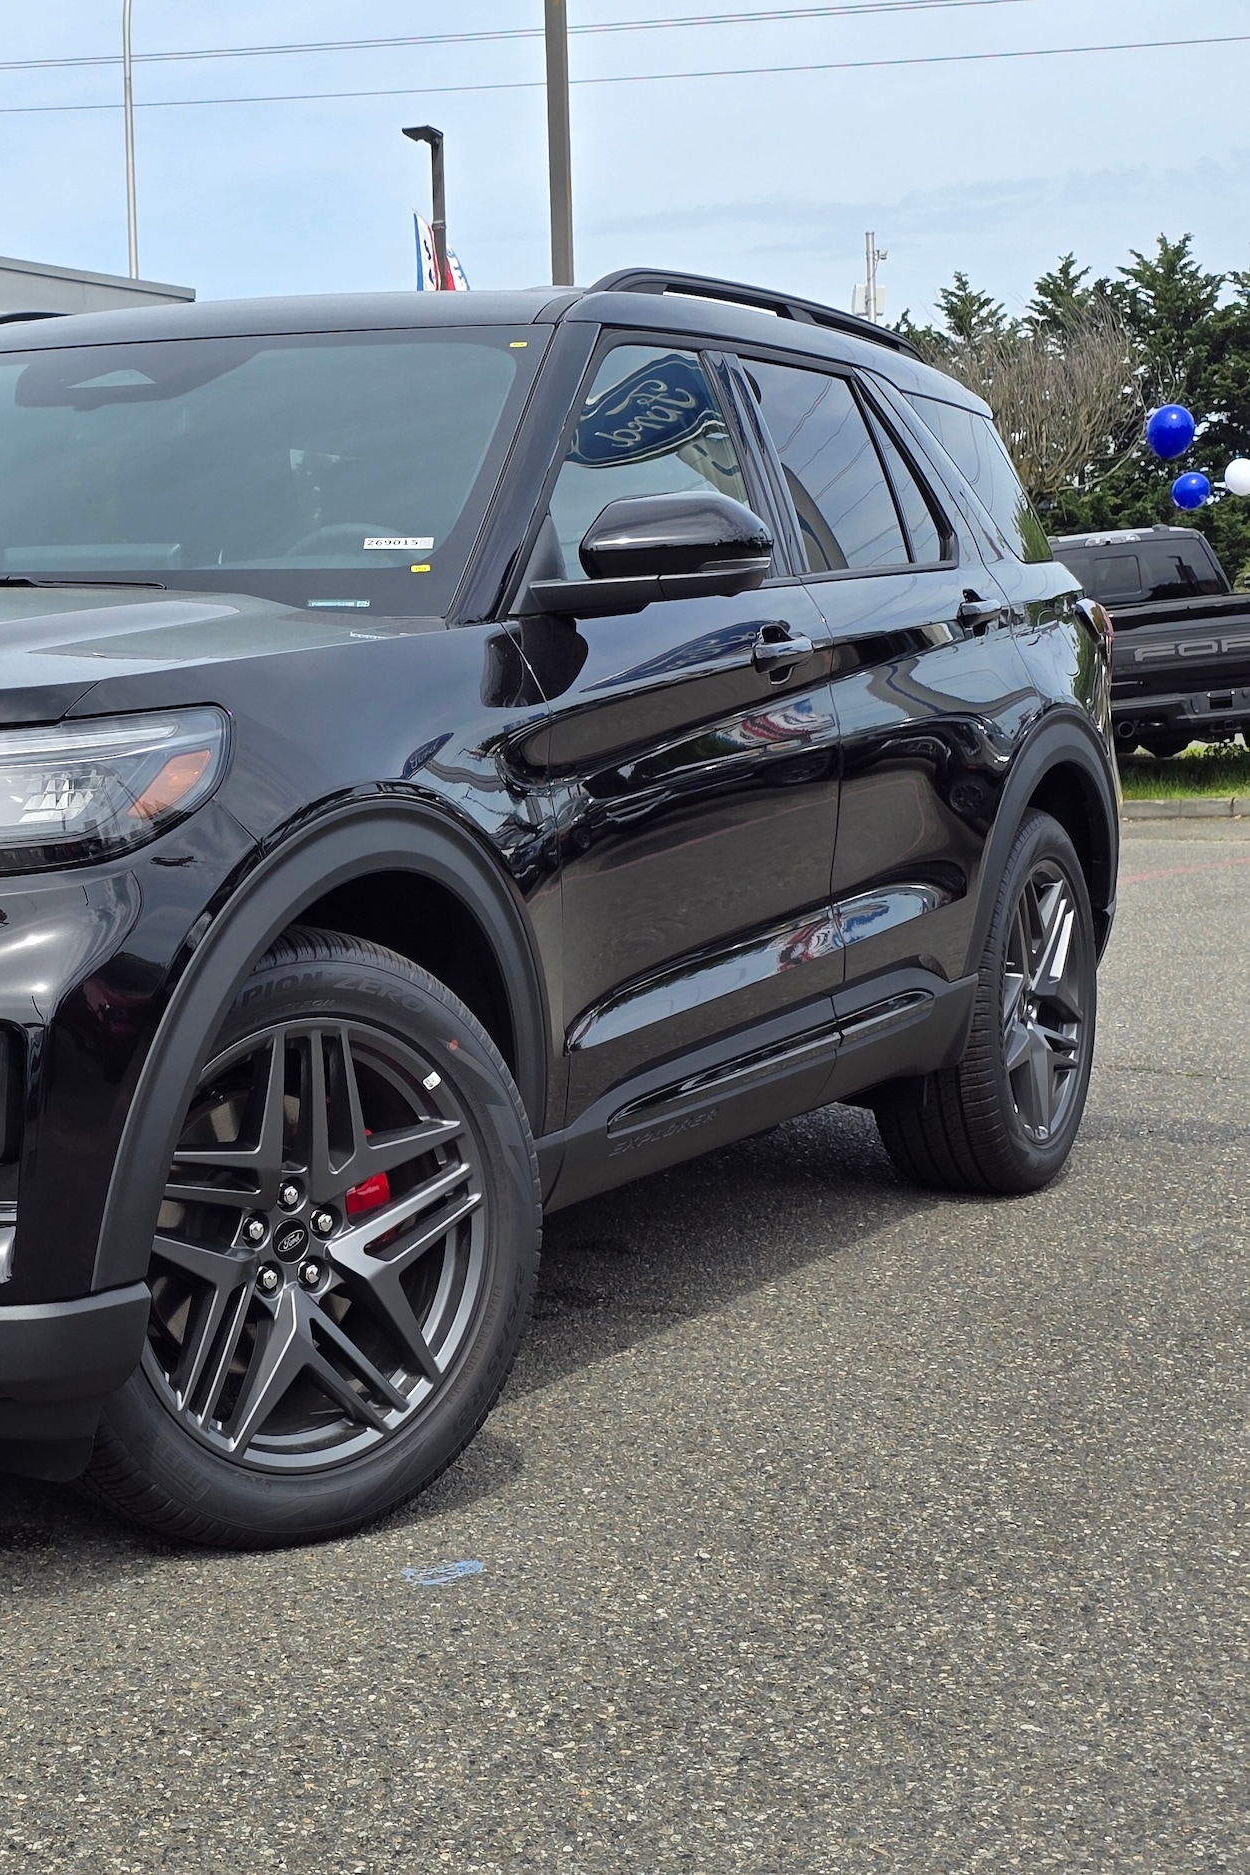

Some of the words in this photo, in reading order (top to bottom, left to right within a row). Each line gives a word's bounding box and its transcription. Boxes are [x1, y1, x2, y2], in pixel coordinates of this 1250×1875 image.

[1133, 637, 1250, 662] FOR
[232, 971, 323, 1009] PION
[333, 973, 428, 1014] ZERO
